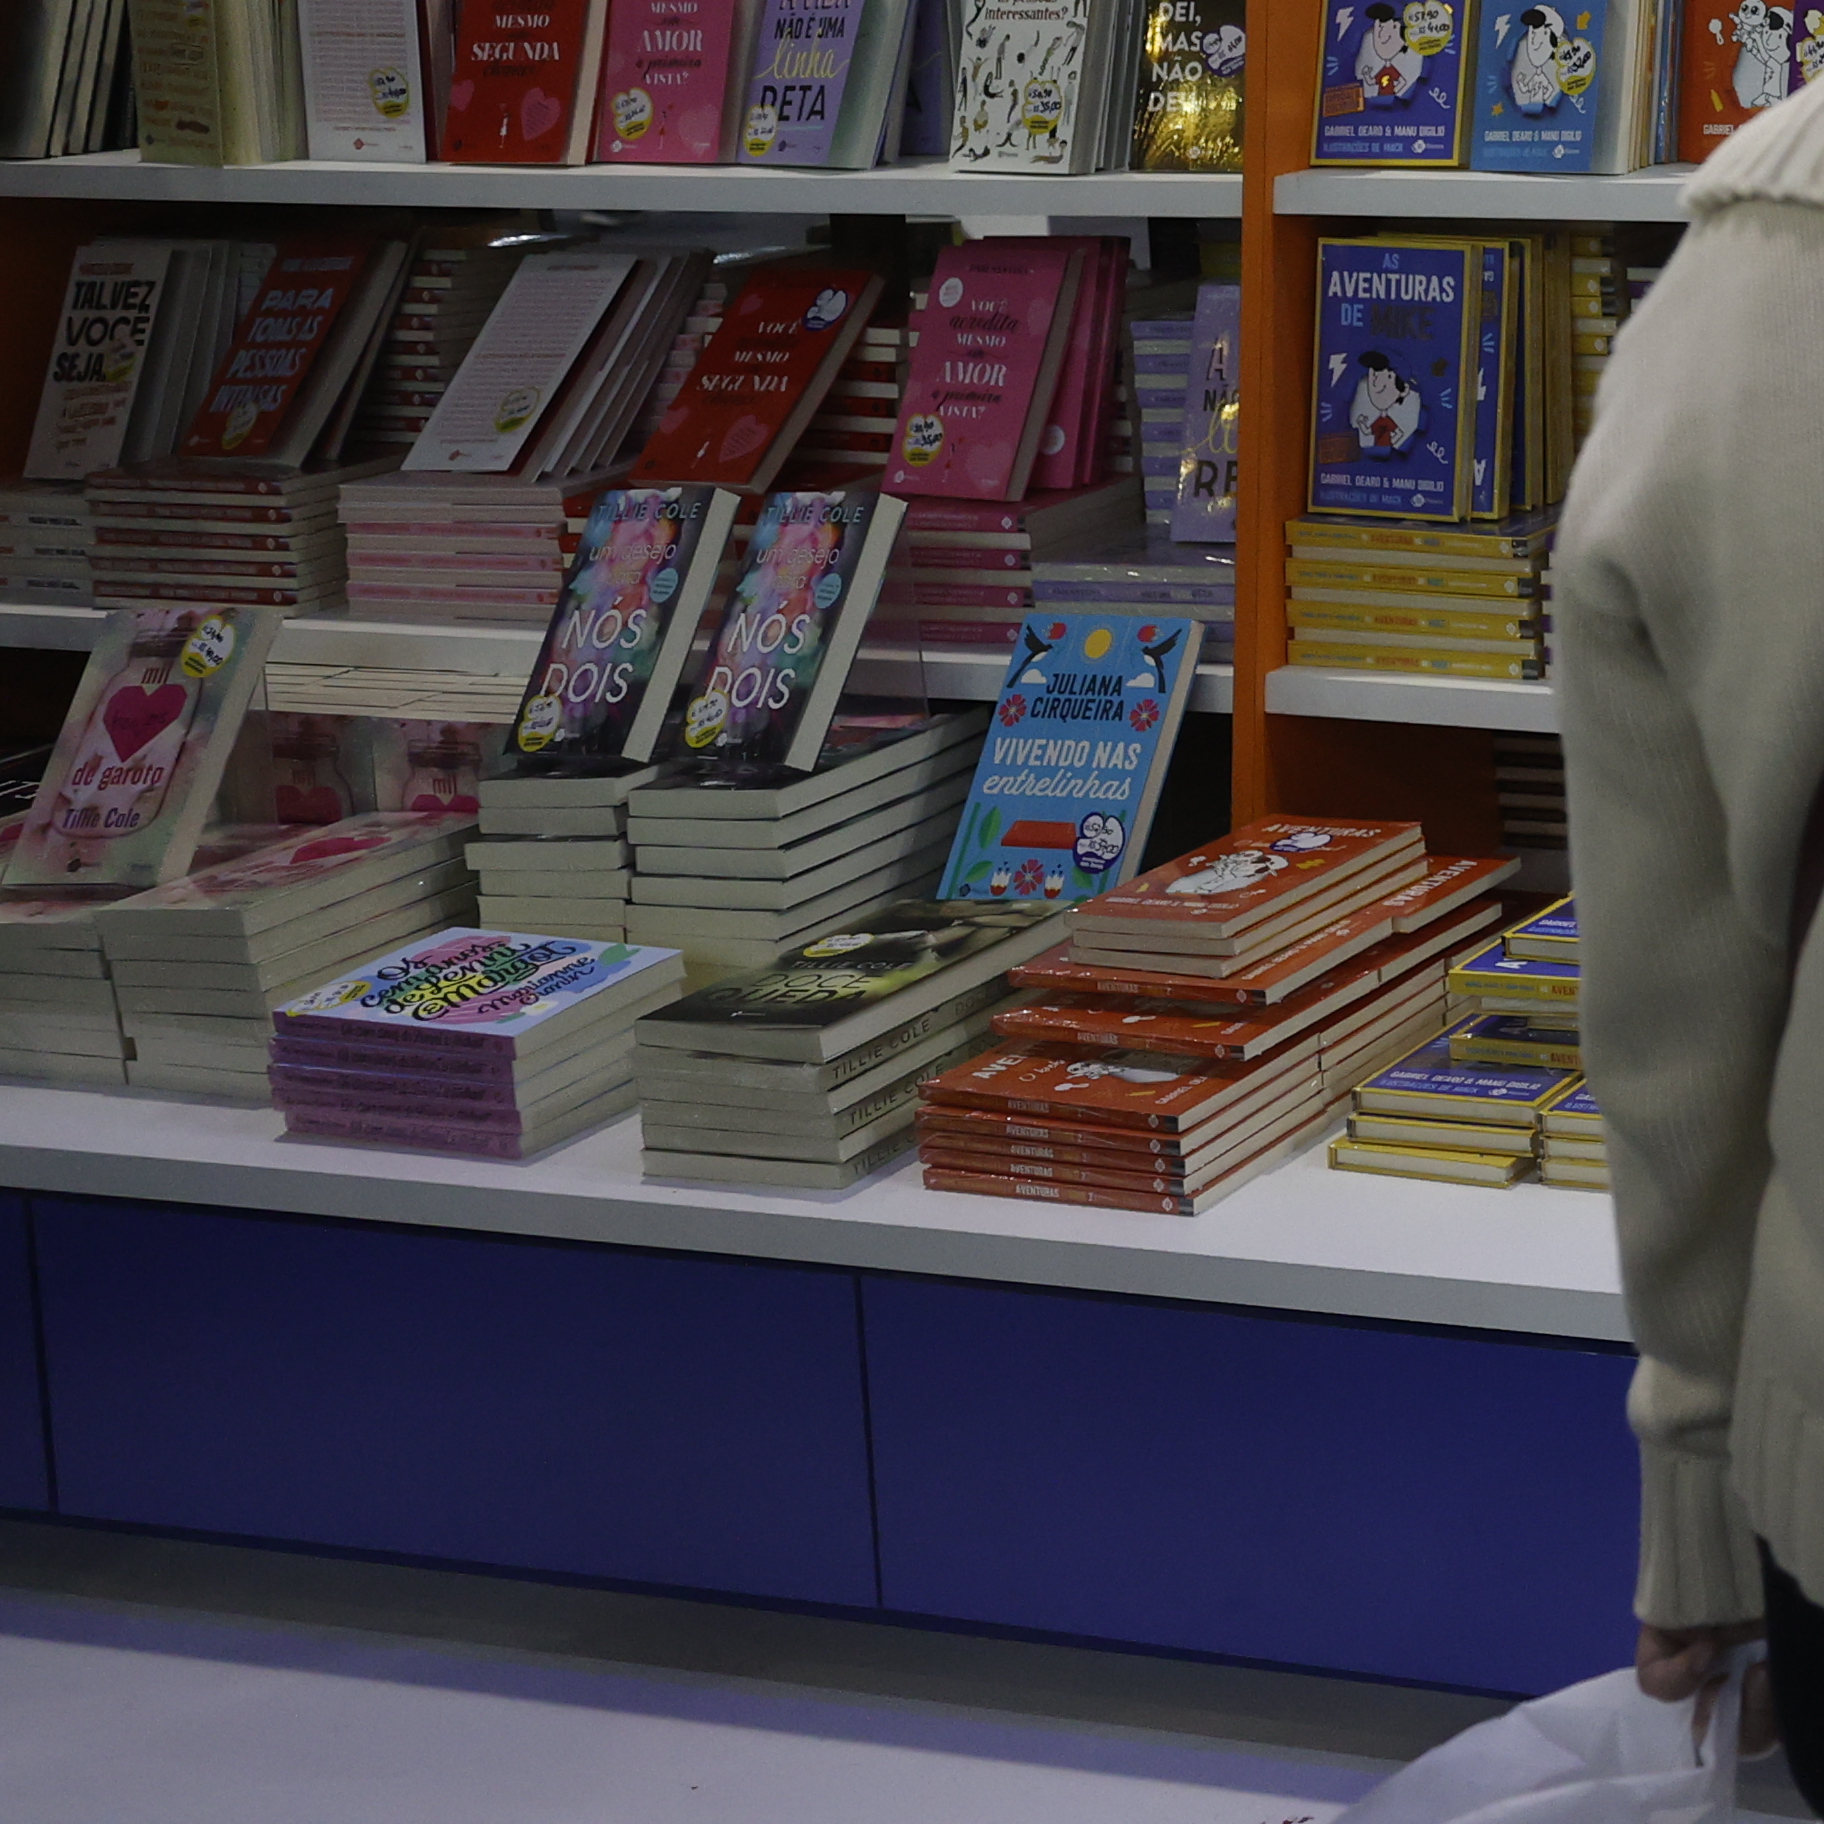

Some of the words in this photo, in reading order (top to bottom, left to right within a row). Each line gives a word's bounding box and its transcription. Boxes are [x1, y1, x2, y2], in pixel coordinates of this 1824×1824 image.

[774, 13, 804, 40] NÃO
[805, 13, 816, 39] É
[817, 16, 845, 39] UMA
[1158, 1, 1201, 27] DEI,
[470, 42, 561, 62] SEGUNDA
[752, 28, 849, 80] linha
[1157, 32, 1203, 52] MAS
[1151, 56, 1203, 83] NÃO
[73, 279, 157, 313] TALVEZ
[261, 288, 335, 311] PARA
[1328, 271, 1456, 303] AVENTURAS
[225, 347, 307, 379] PESSOAS
[654, 501, 702, 520] COLE
[561, 596, 647, 649] NÓS
[140, 665, 172, 685] mil
[539, 663, 635, 705] DOIS
[1045, 672, 1123, 697] JULIANA
[1030, 696, 1125, 723] CIRQUEIRA
[993, 736, 1091, 768] VIVENDO
[1092, 740, 1142, 770] NAS
[71, 761, 94, 787] de
[97, 762, 165, 790] garoto
[982, 768, 1131, 801] entrelinhas
[62, 806, 100, 829] Tillie
[104, 807, 141, 829] Cole
[752, 972, 870, 990] DOCE
[705, 987, 868, 1005] QUEDA
[831, 1042, 894, 1082] TILLIE
[888, 1018, 933, 1050] COLE
